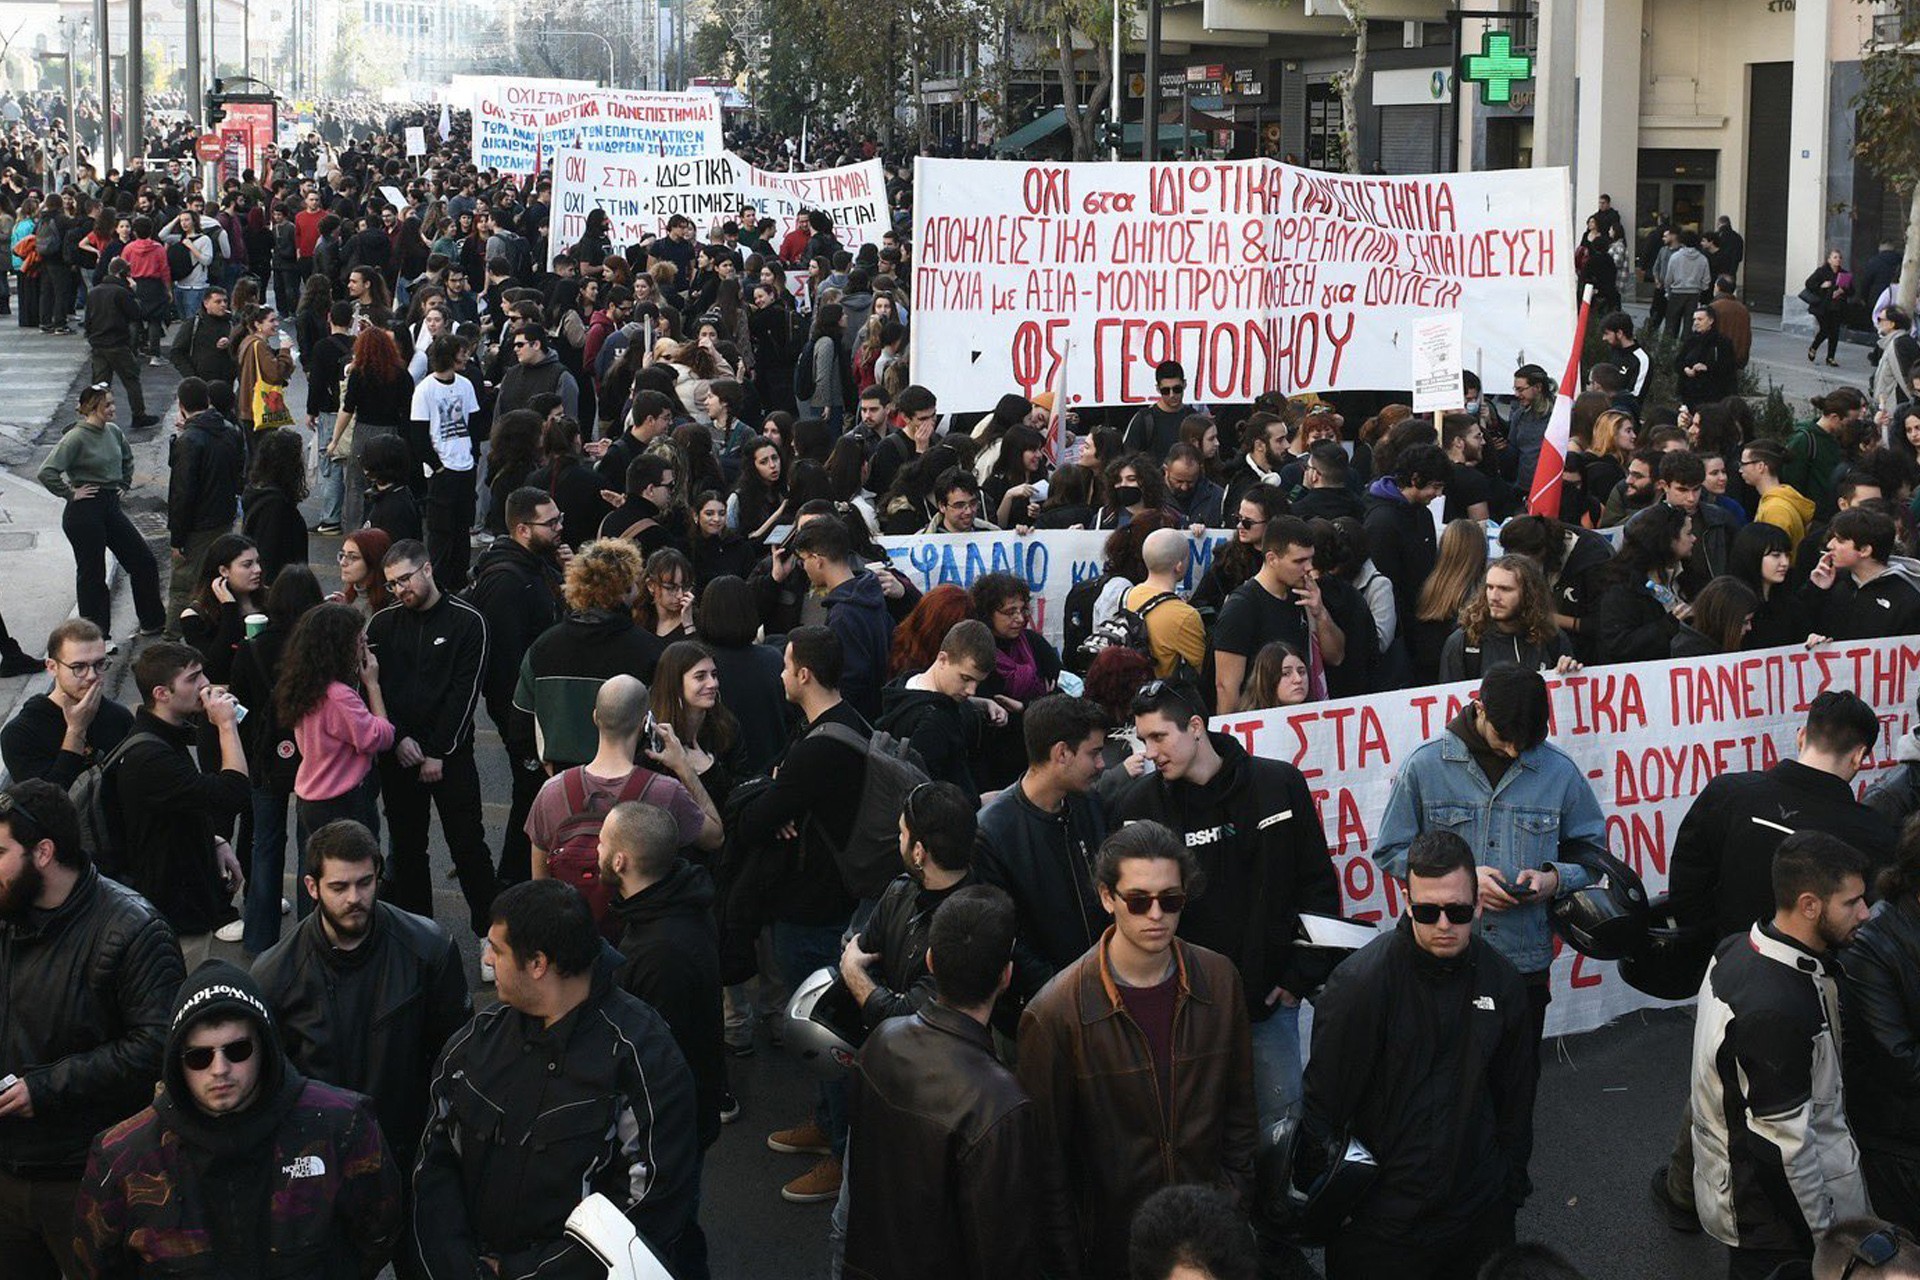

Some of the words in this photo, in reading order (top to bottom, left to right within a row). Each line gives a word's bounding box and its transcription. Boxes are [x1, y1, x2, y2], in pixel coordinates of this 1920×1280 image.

[507, 87, 535, 104] ΟΧΙ
[538, 91, 563, 105] ΣΤΑ
[510, 112, 538, 127] ΣΤΑ
[545, 100, 600, 126] ΙΔΙΩΤΙΚΑ
[607, 101, 713, 122] ΠΑΝΕΠΙΣΤΗΜΙΑ!
[482, 121, 509, 135] ΤΩΡΑ
[581, 126, 602, 138] ΤΩΝ
[565, 156, 586, 183] ΟΧΙ
[603, 166, 637, 187] ΣΤΑ
[656, 158, 734, 188] ΙΔΙΩΤΙΚΑ
[564, 191, 585, 214] ΟΧΙ
[652, 192, 744, 215] ΙΣΟΤΙΜΗΣΗ
[750, 198, 770, 214] ΜΕ
[777, 199, 795, 216] ΤΑ
[1023, 167, 1071, 215] ΟΧΙ
[1149, 163, 1282, 215] ΙΔΙΩΤΙΚΑ
[1292, 172, 1456, 232] ΠΑΝΕΠΙΣΤΗΜΙΑ
[922, 214, 1096, 264] ΑΠΟΚΛΕΙΣΤΙΚΑ
[1111, 219, 1230, 264] ΔΗΜΟΣΙΑ
[1242, 219, 1268, 263] &
[916, 268, 982, 312] ΠΤΥΧΙΑ
[1286, 705, 1391, 779] ΣΤΑ
[282, 1163, 311, 1173] NORTH
[291, 1169, 311, 1179] FACE
[294, 1157, 311, 1165] THE
